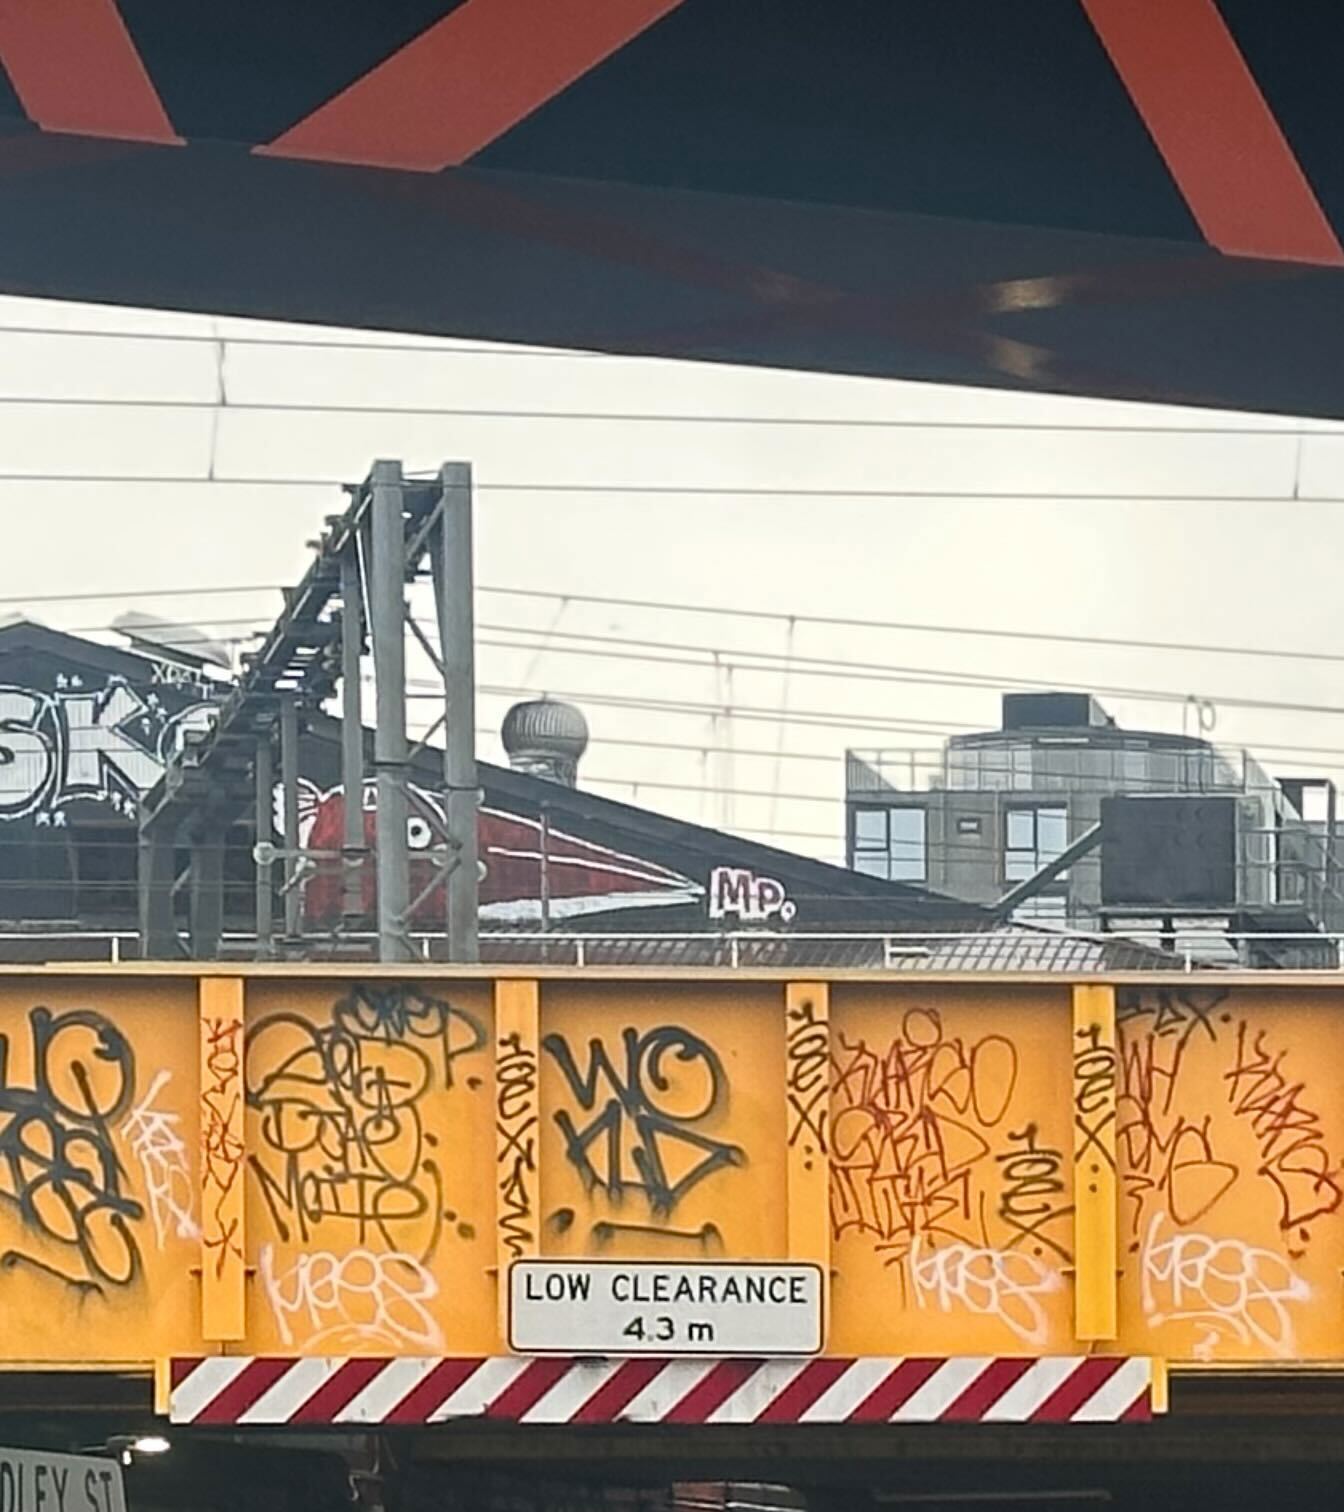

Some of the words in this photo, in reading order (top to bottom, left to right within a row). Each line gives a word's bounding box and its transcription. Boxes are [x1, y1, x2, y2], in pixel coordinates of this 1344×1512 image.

[525, 1273, 591, 1301] LOW
[611, 1274, 808, 1304] CLEARANCE
[622, 1316, 675, 1341] 4.3
[688, 1321, 714, 1342] m
